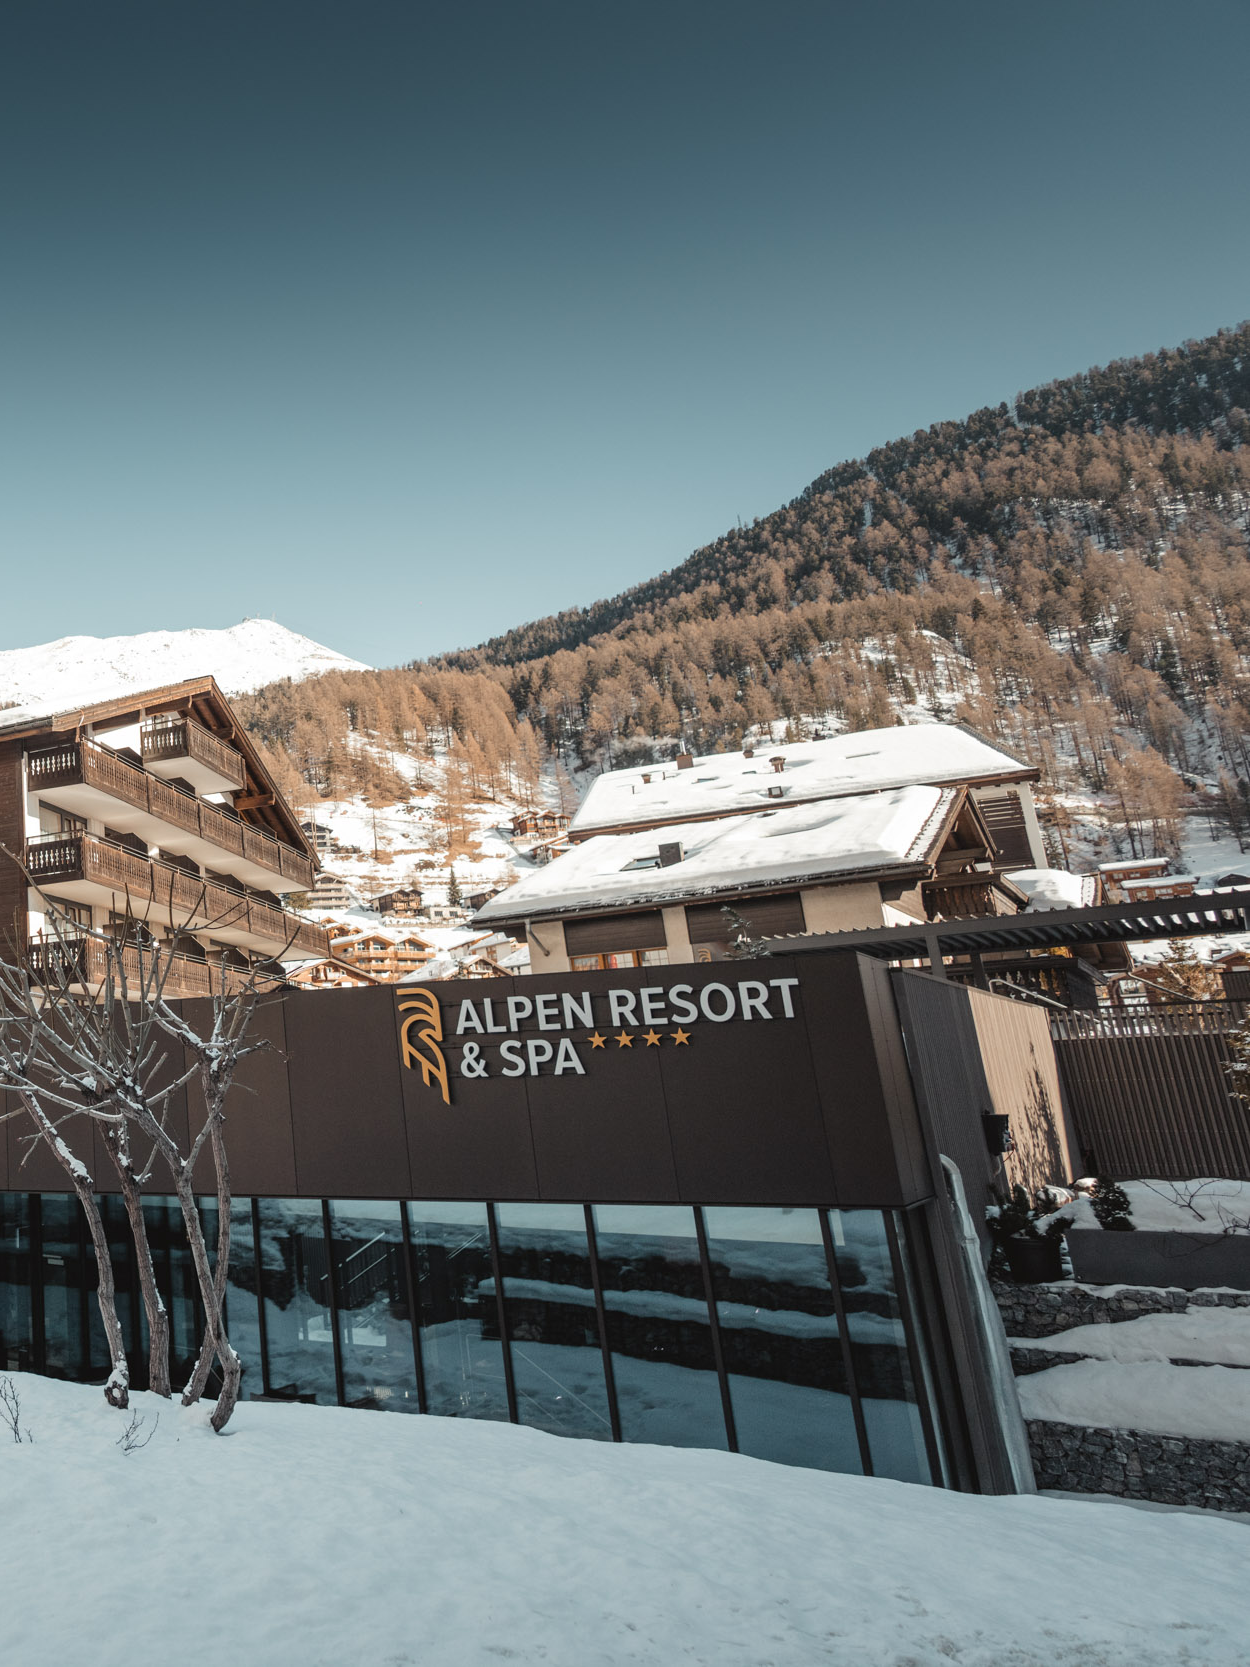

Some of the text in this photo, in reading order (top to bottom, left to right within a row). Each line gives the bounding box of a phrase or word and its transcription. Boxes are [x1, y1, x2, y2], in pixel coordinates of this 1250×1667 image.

[456, 978, 799, 1035] ALPEN RESORT
[460, 1038, 586, 1078] & SPA
